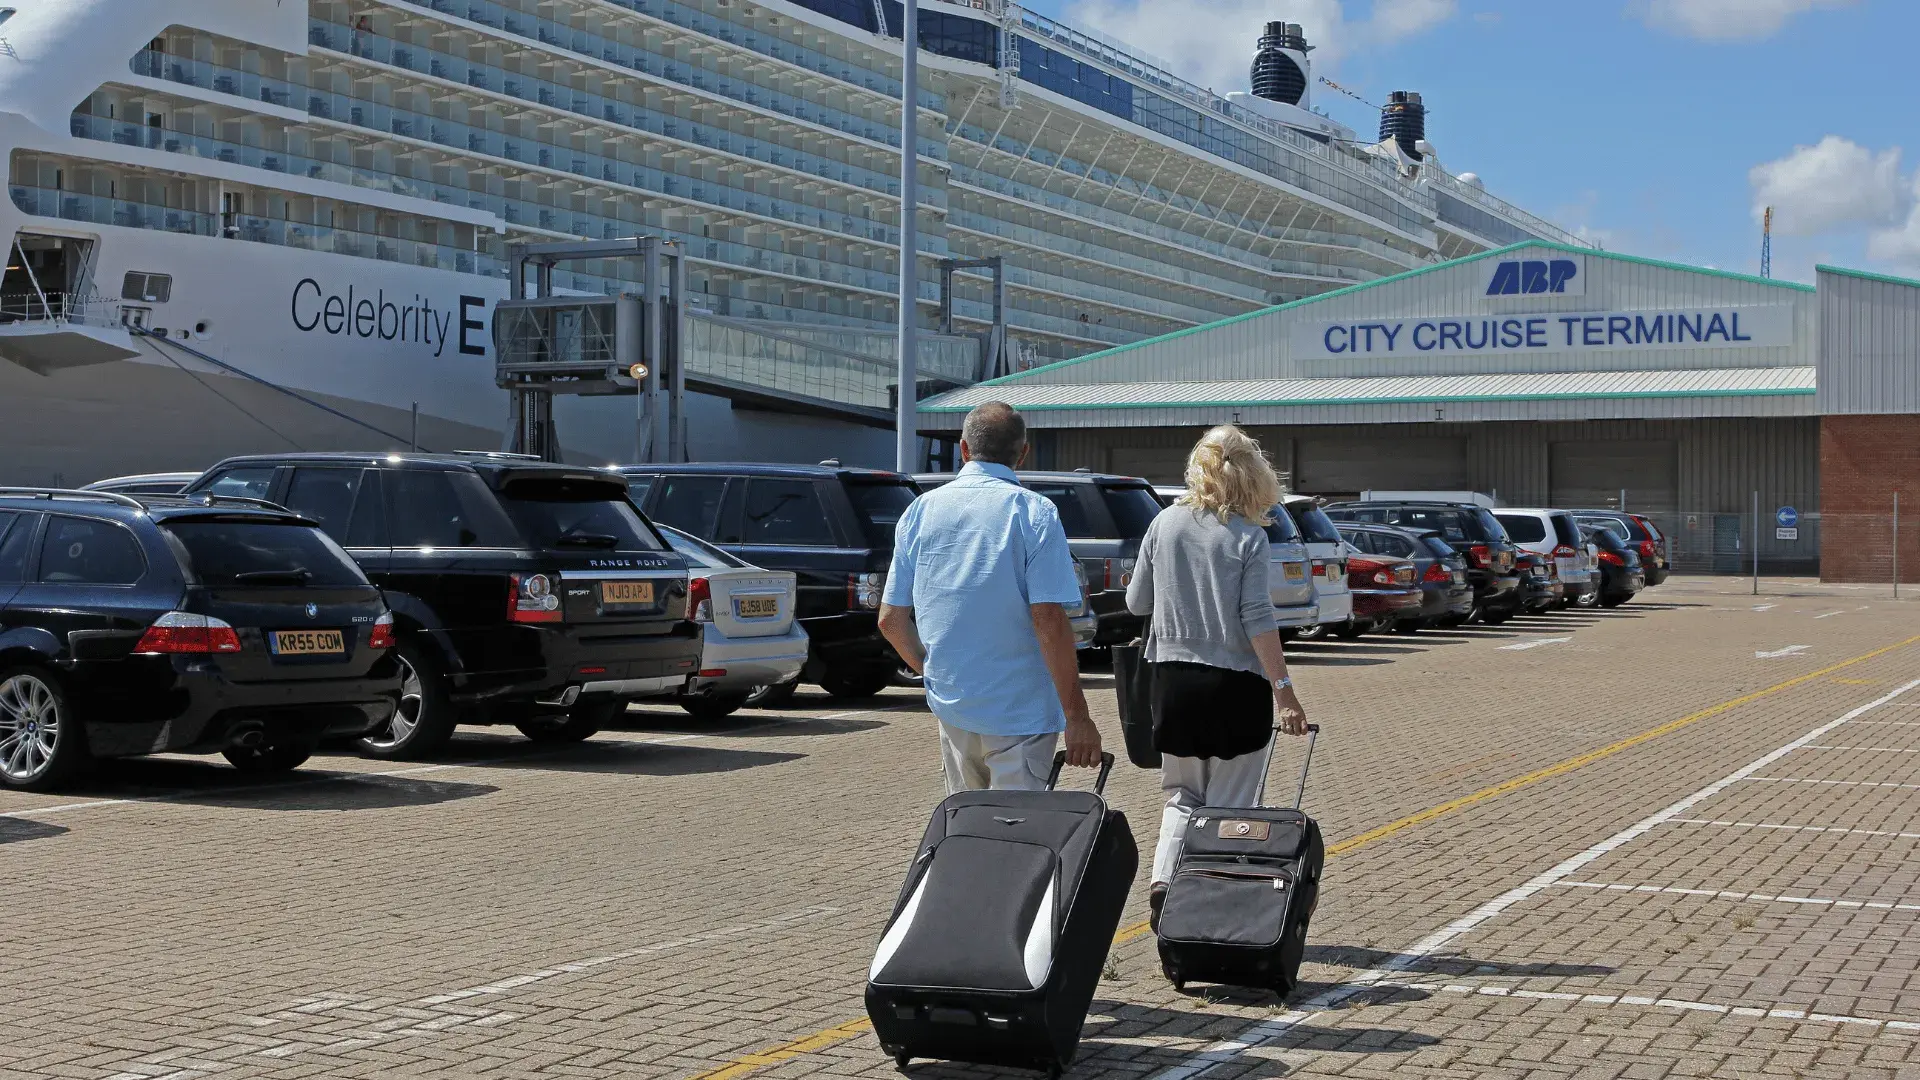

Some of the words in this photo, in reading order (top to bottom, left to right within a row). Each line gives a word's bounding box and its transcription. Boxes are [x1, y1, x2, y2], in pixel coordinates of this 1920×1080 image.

[1486, 260, 1577, 295] ABP
[292, 278, 451, 357] Celebrity
[459, 294, 497, 356] E
[1324, 324, 1403, 353] CITY
[1412, 318, 1548, 351] CRUISE
[1558, 312, 1752, 346] TERMINAL
[590, 559, 631, 567] RANGE
[608, 584, 630, 600] NJ13
[632, 584, 649, 599] APJ
[278, 633, 315, 652] KR55
[316, 632, 343, 650] COM
